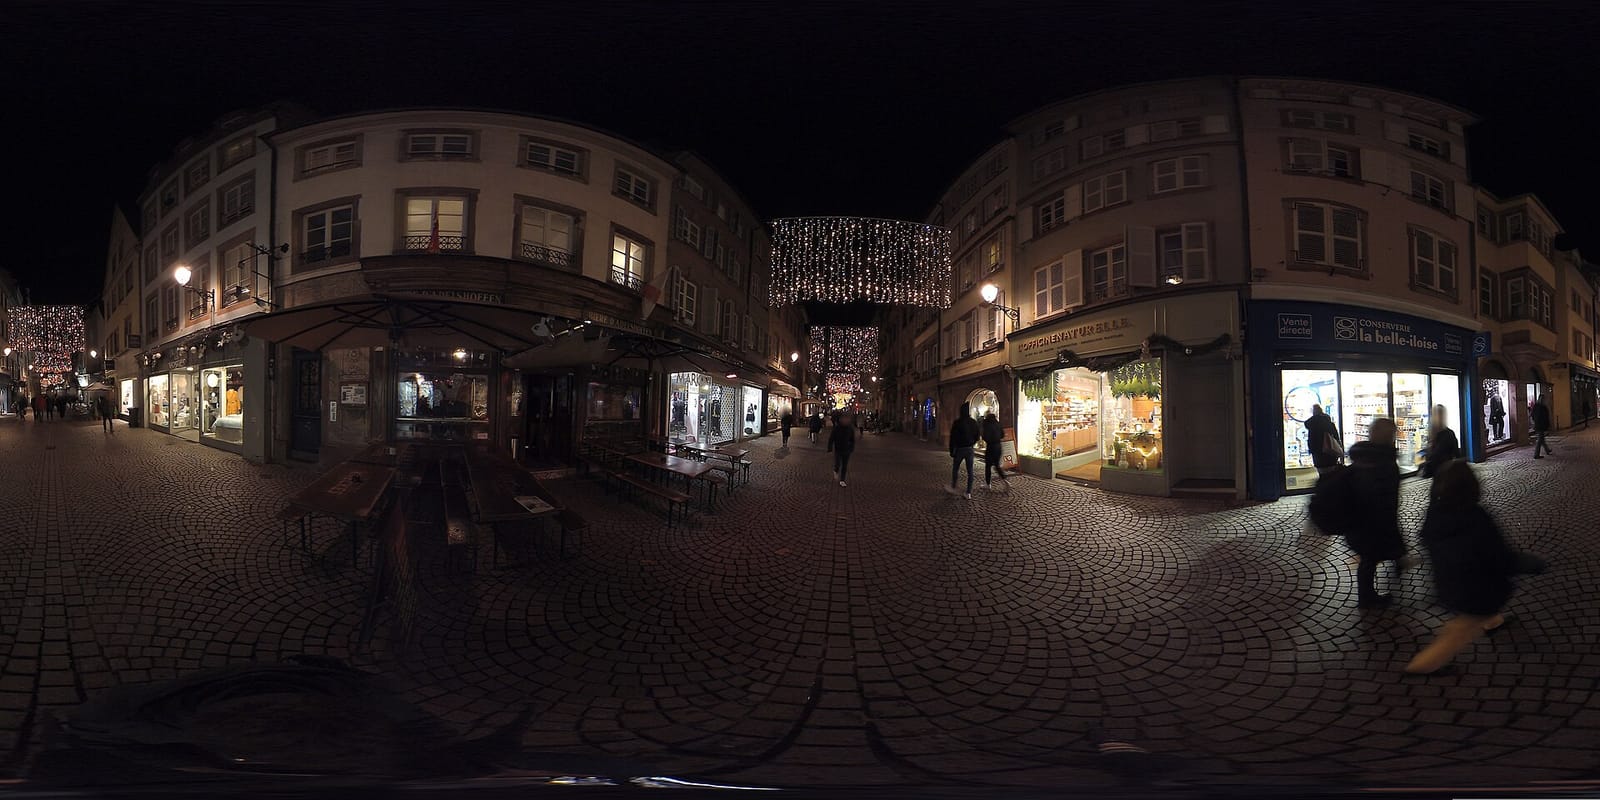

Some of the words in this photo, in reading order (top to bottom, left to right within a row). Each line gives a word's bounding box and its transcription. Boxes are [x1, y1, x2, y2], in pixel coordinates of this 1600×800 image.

[1282, 317, 1309, 327] Vente
[1359, 318, 1411, 333] CONSERVERIE
[1280, 326, 1311, 335] directe
[1359, 328, 1372, 343] la
[1375, 330, 1438, 350] belle-iloise
